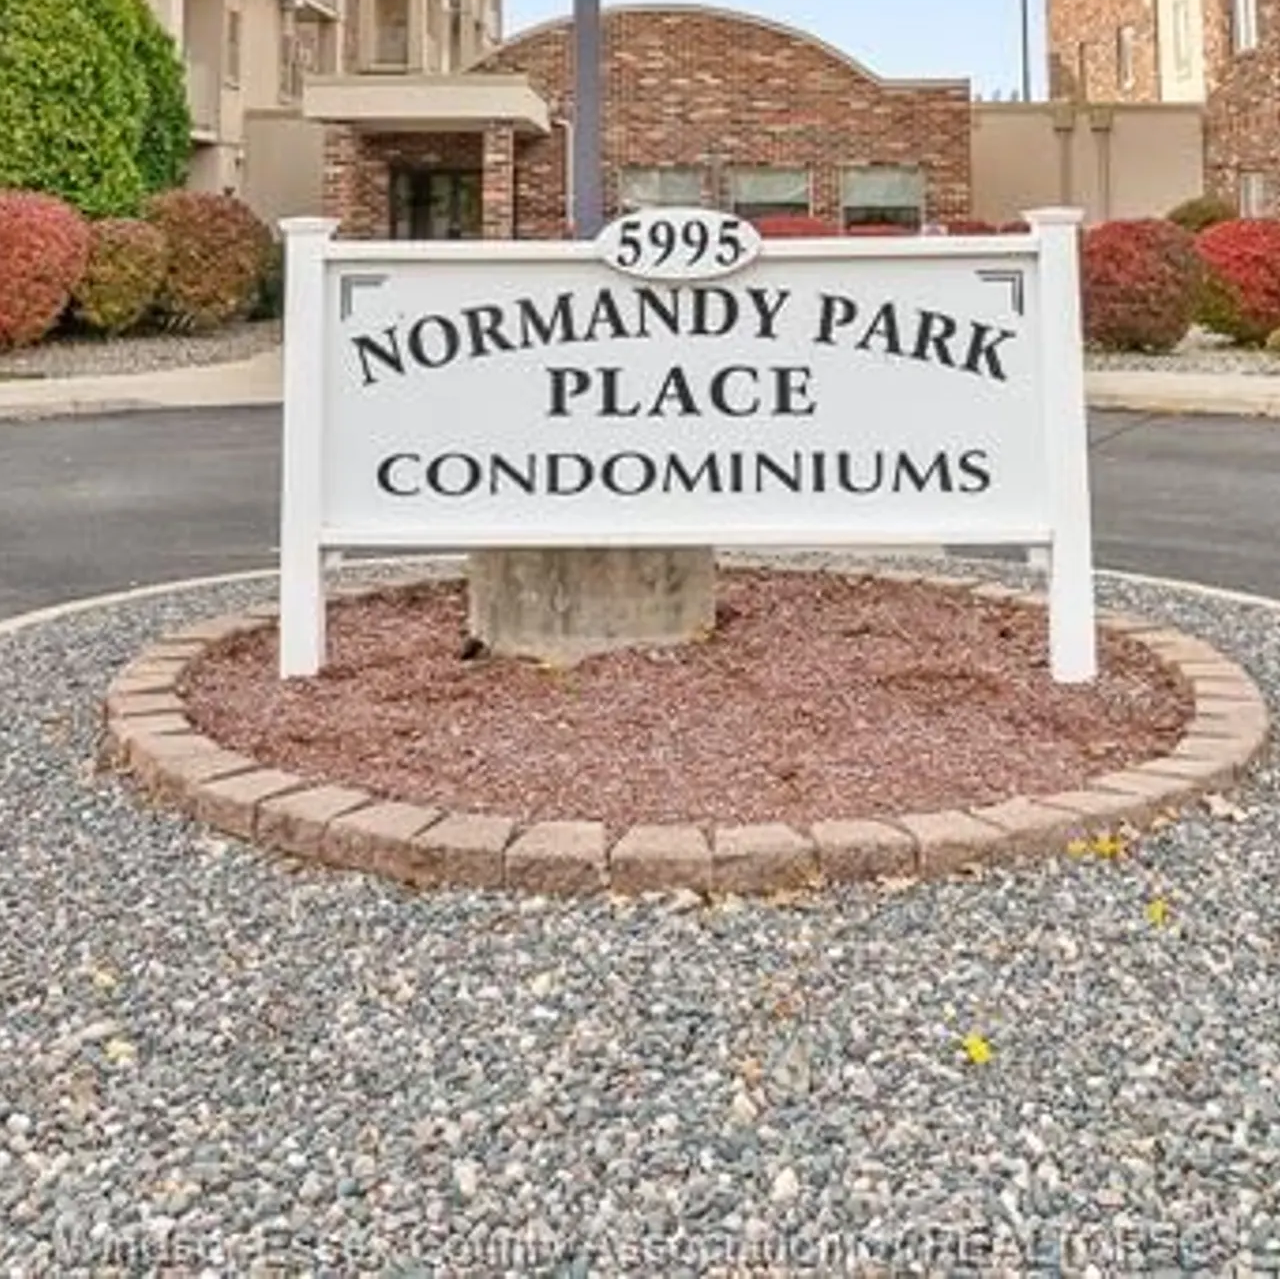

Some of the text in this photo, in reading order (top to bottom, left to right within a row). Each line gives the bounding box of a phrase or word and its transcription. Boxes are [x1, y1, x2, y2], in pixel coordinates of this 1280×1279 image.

[617, 220, 746, 267] 5995
[351, 284, 1016, 386] NORMANDY PARK
[546, 366, 817, 417] PLACE
[377, 449, 991, 496] CONDOMINIUMS
